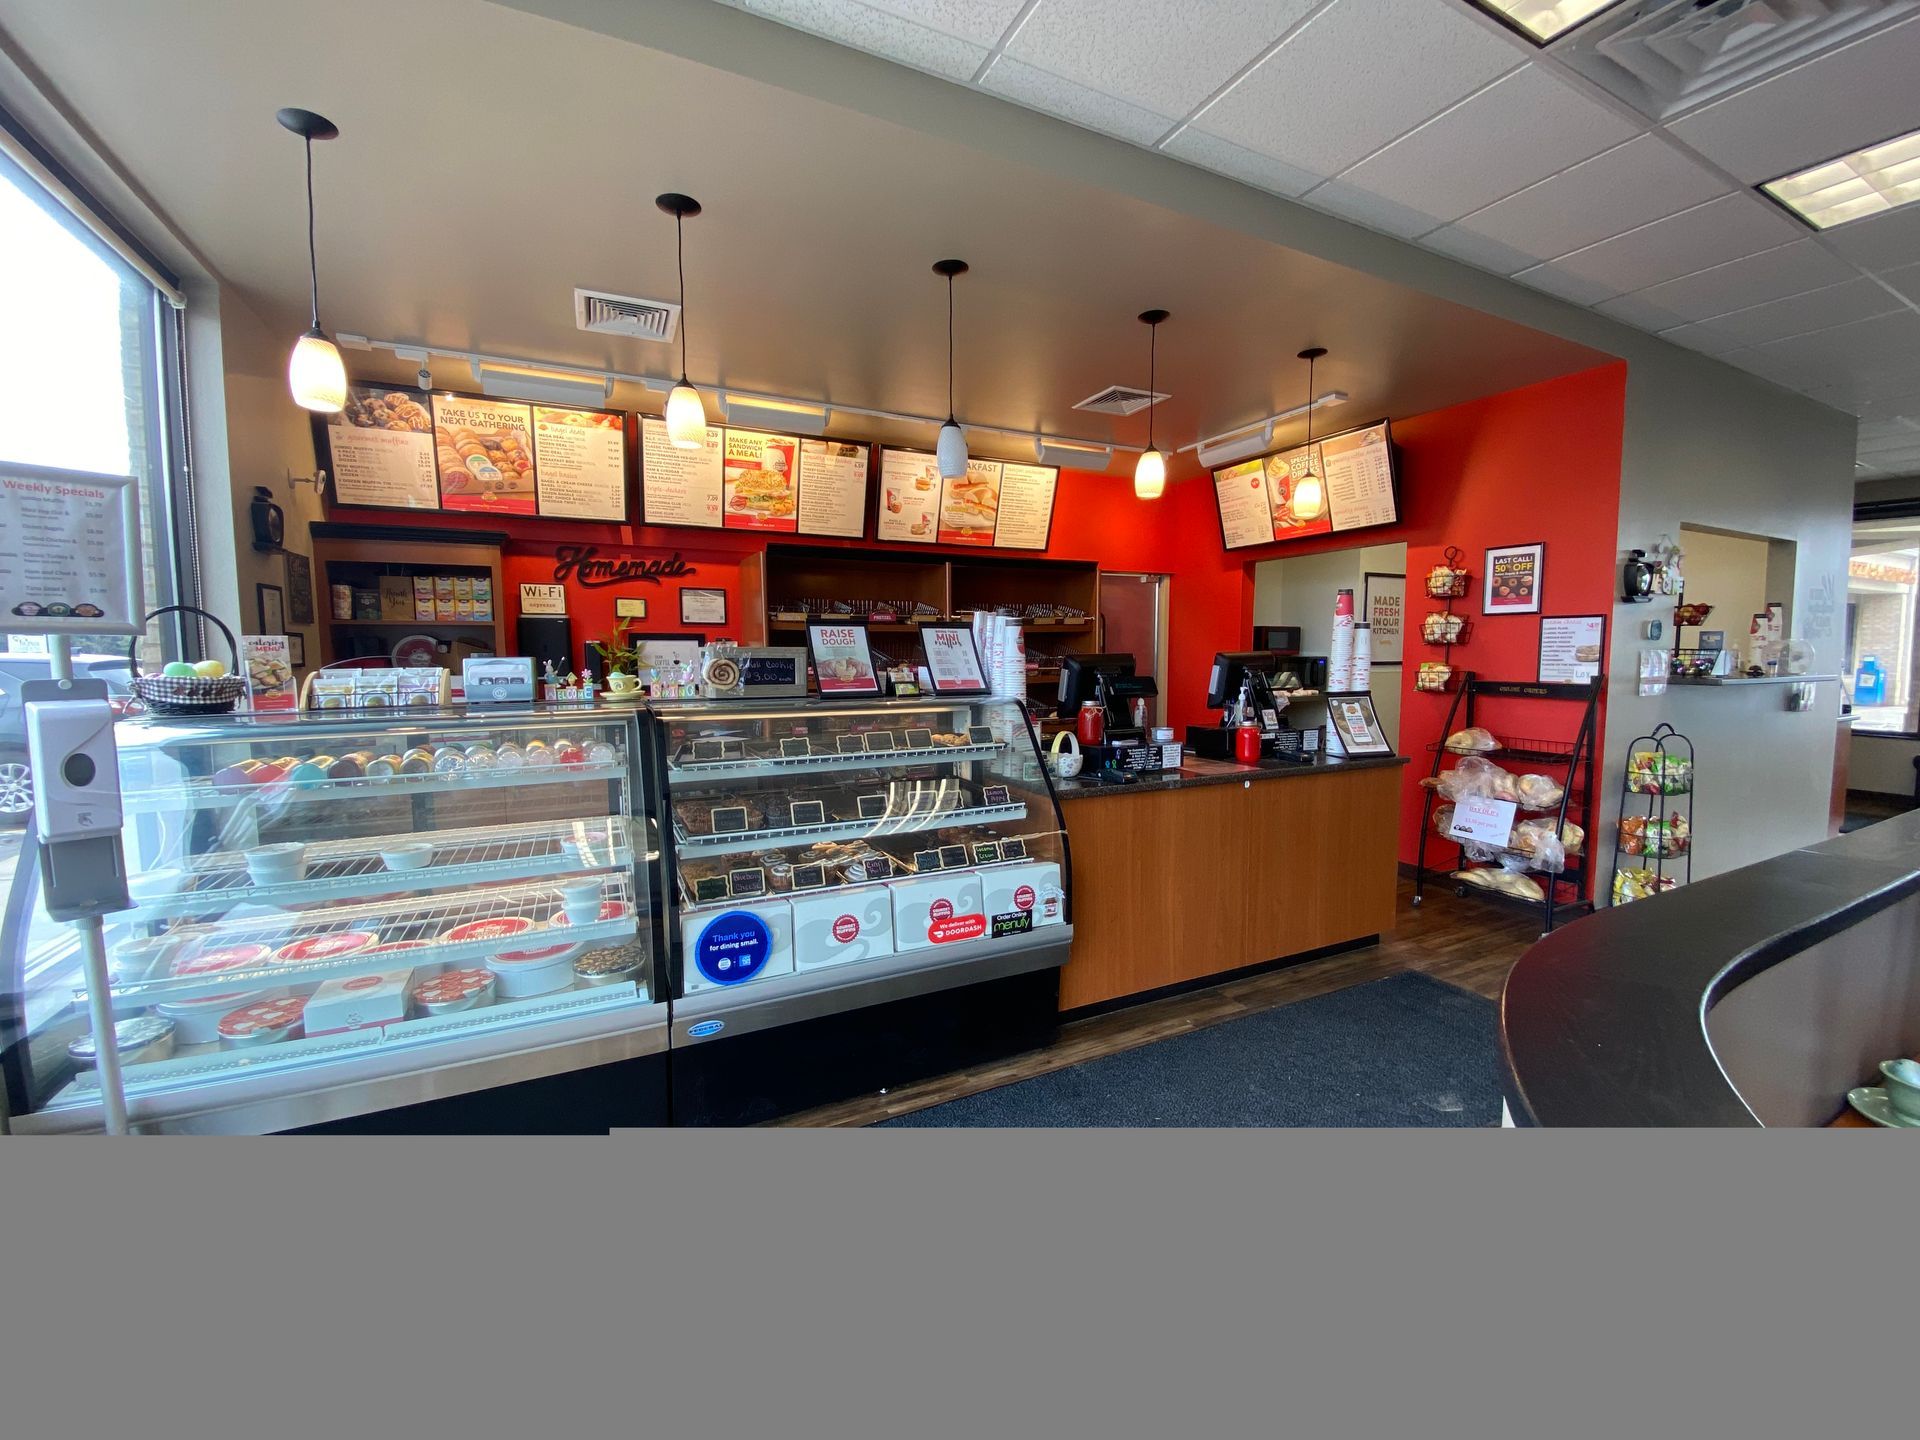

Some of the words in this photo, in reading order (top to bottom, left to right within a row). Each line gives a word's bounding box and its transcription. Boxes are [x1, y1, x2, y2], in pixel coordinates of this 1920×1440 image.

[441, 408, 466, 418] TAKE
[468, 411, 480, 419] US
[482, 412, 495, 420] TO
[498, 414, 524, 424] YOUR
[440, 415, 468, 426] NEXT
[469, 419, 526, 432] GATHERING
[728, 443, 763, 452] SANDWICH
[736, 450, 762, 459] MEAL!
[967, 462, 999, 473] AKFAST
[1291, 459, 1319, 471] COFFEE
[2, 479, 53, 495] Weekly
[55, 485, 105, 499] Specials
[1495, 557, 1511, 565] LAST
[1513, 562, 1533, 571] OFF
[554, 545, 697, 589] Homemade
[523, 585, 562, 598] Wi-Fi
[1373, 595, 1401, 607] MADE
[1373, 607, 1400, 617] FRESH
[1373, 618, 1382, 627] IN
[1382, 618, 1400, 627] OUR
[820, 629, 855, 638] RAISE
[1372, 627, 1399, 635] KITCHEN
[822, 638, 856, 646] DOUGH
[936, 633, 959, 641] MINI
[1011, 911, 1027, 919] Online
[945, 924, 982, 936] DOORDASH
[993, 917, 1031, 932] menufy
[712, 932, 739, 943] Thank
[740, 931, 755, 940] you
[720, 942, 740, 950] dining
[740, 938, 759, 947] small.
